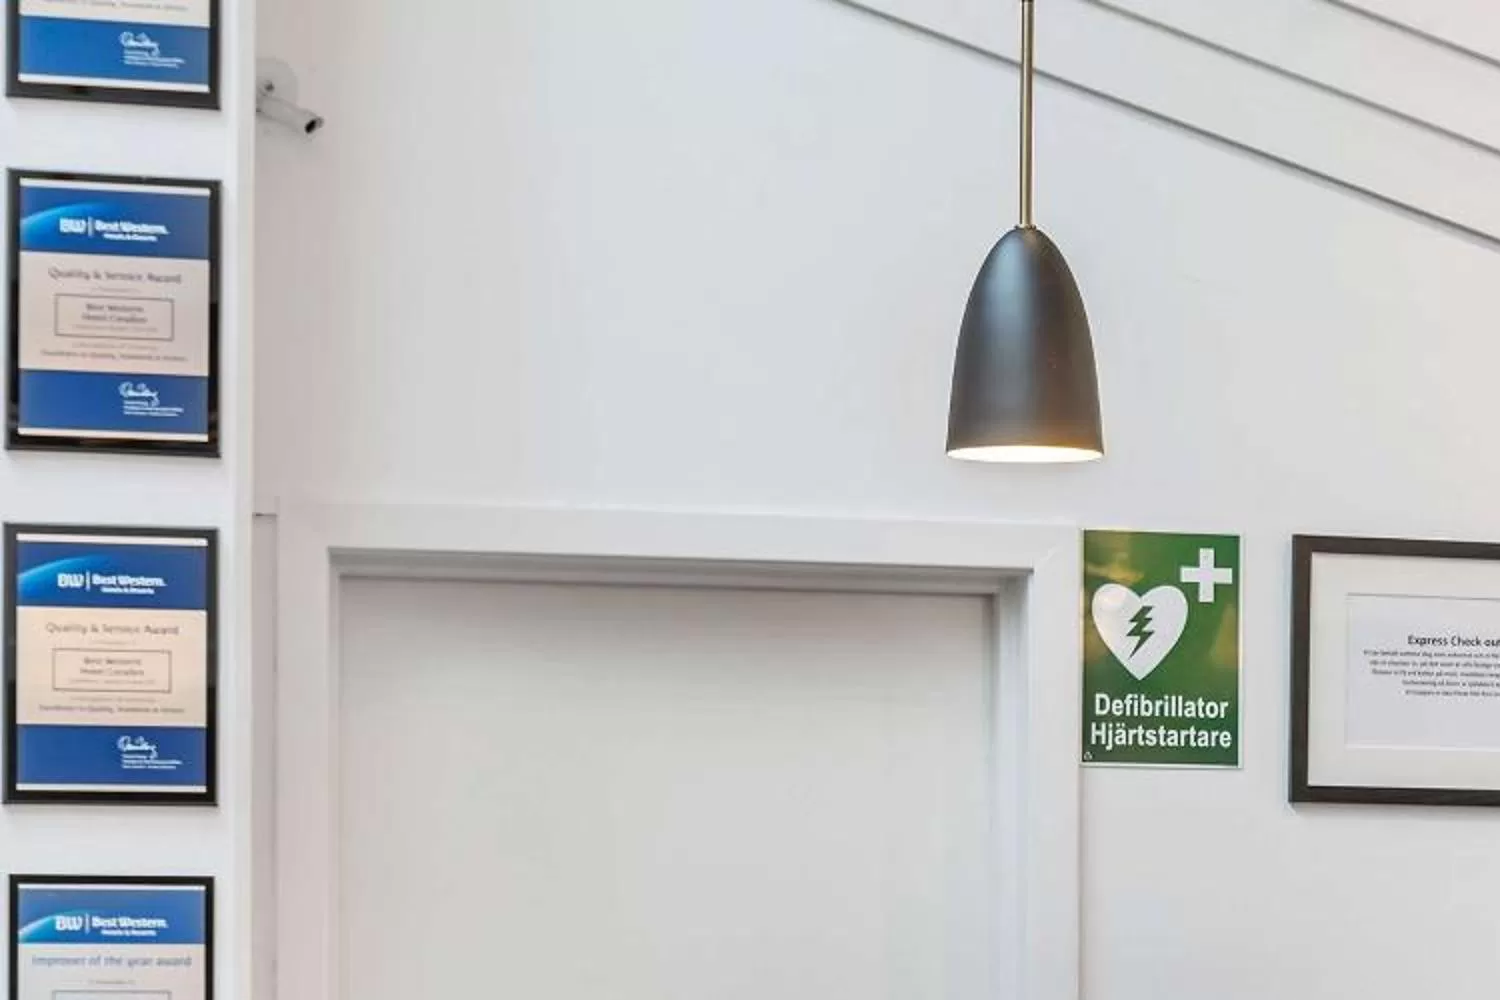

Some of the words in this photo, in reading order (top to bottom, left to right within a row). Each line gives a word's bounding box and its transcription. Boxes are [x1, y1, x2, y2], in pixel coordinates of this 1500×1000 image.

[1407, 634, 1448, 647] Express
[1095, 692, 1229, 719] Defibrillator
[1091, 721, 1232, 751] Hjärtstartare
